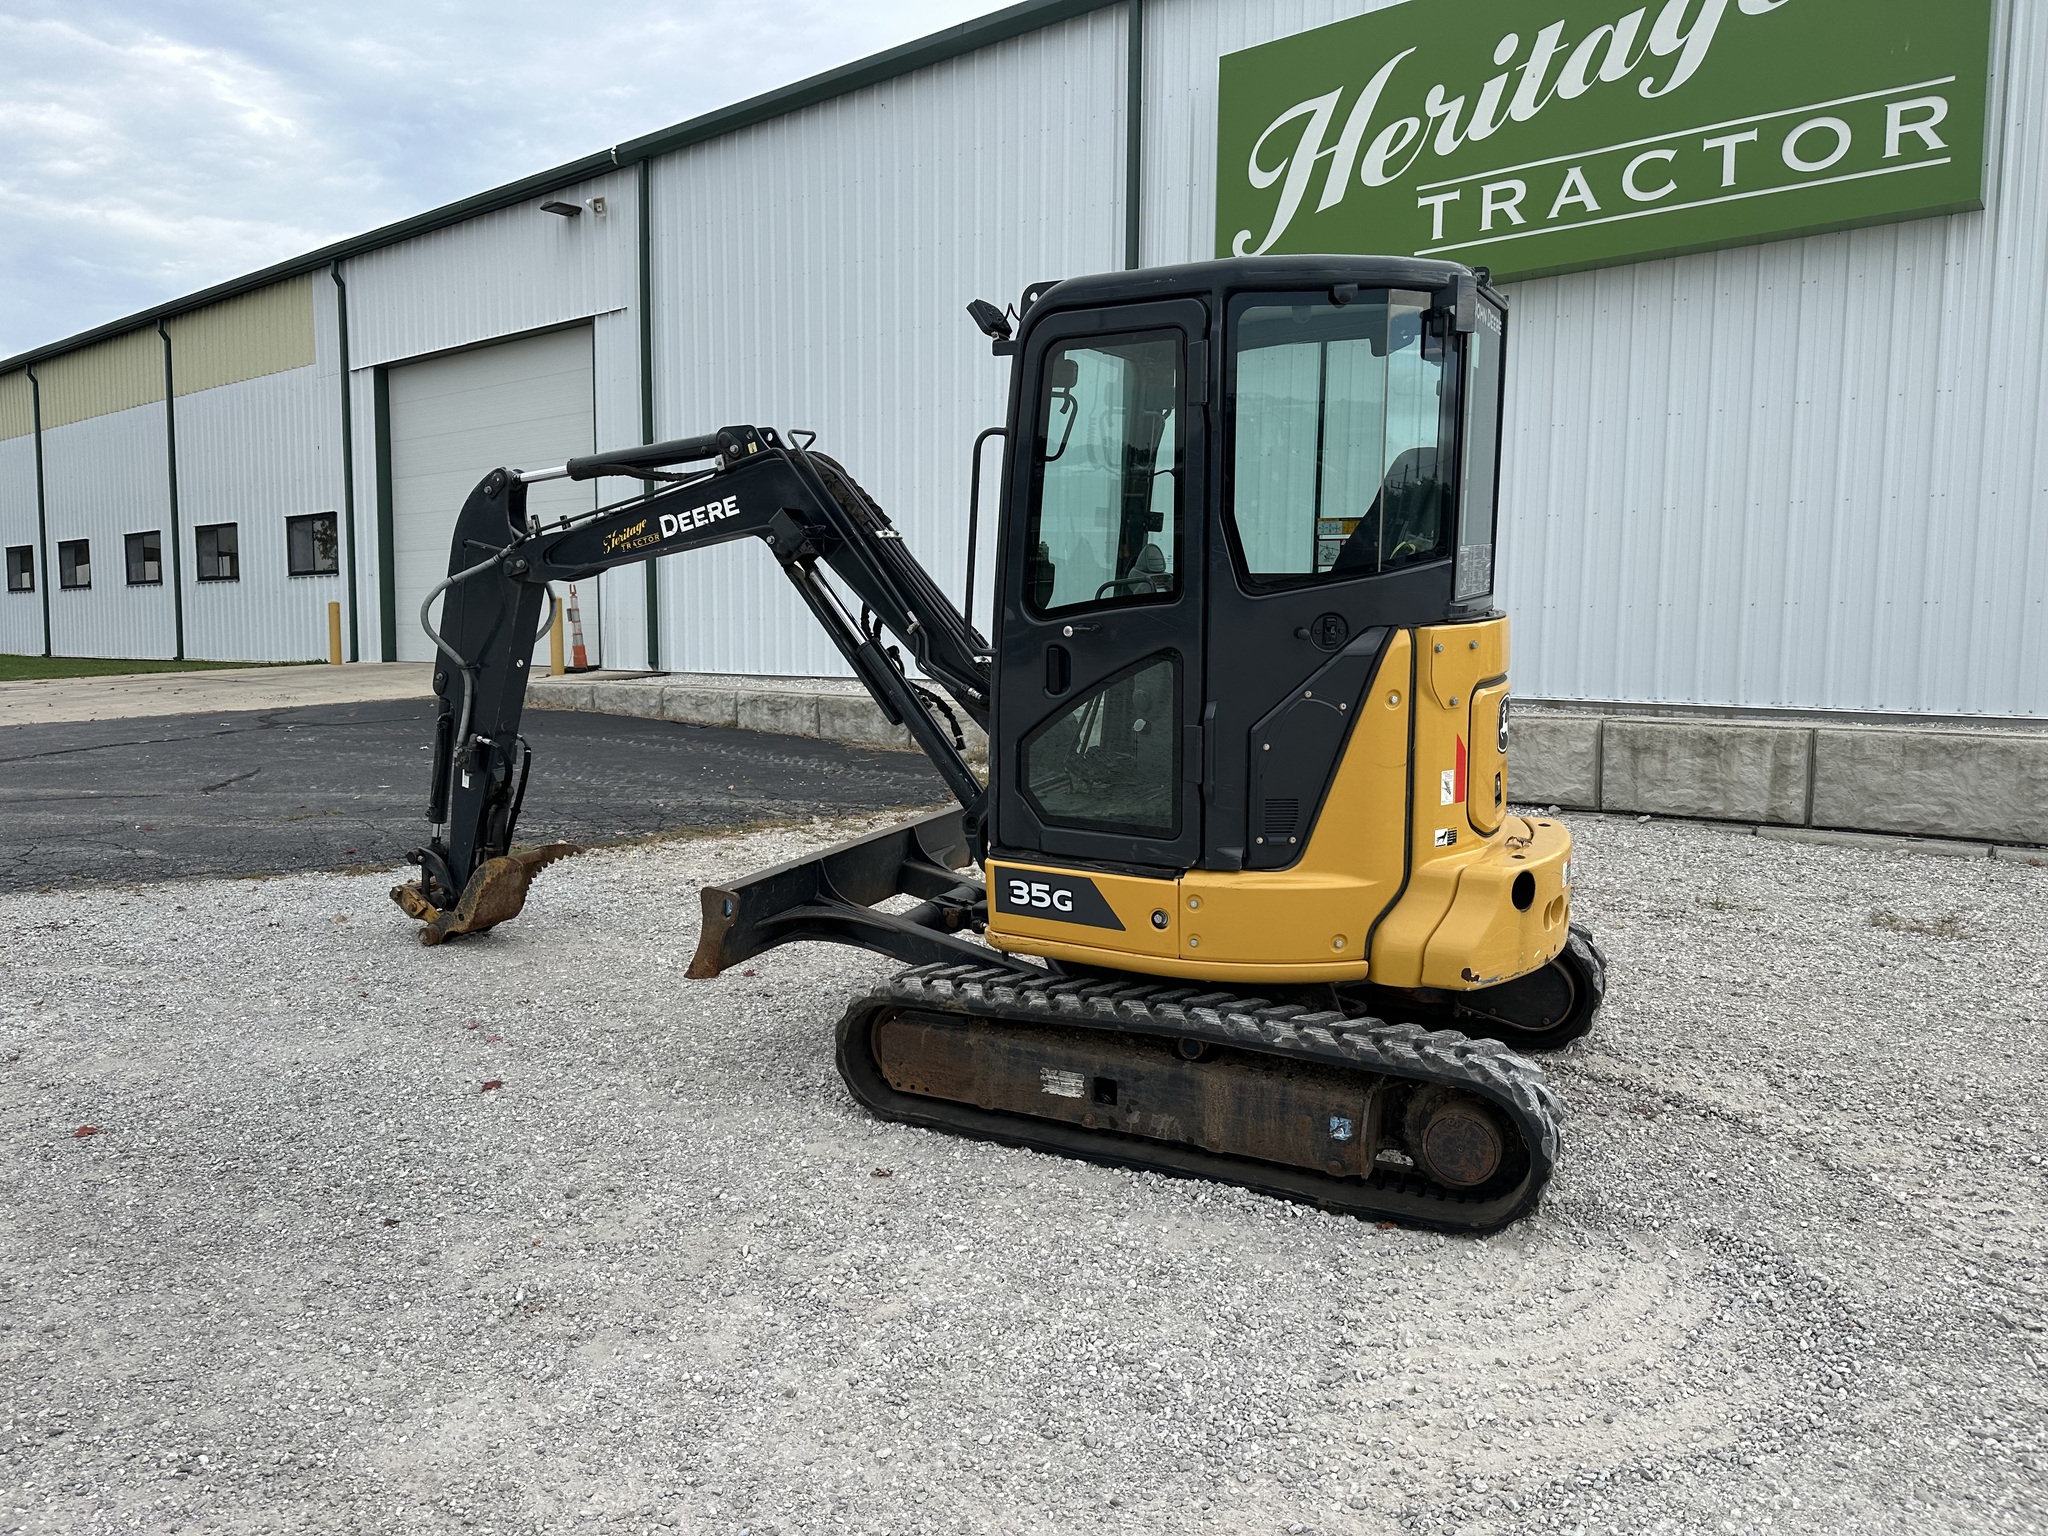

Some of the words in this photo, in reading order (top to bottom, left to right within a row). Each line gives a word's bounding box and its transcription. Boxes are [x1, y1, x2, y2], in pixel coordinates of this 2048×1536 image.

[1233, 0, 1790, 257] Heritag
[1416, 95, 1950, 241] TRACTOR
[658, 494, 741, 539] DEERE
[602, 519, 647, 555] Heritage
[620, 534, 660, 553] TRACTOR
[1008, 880, 1073, 912] 35G
